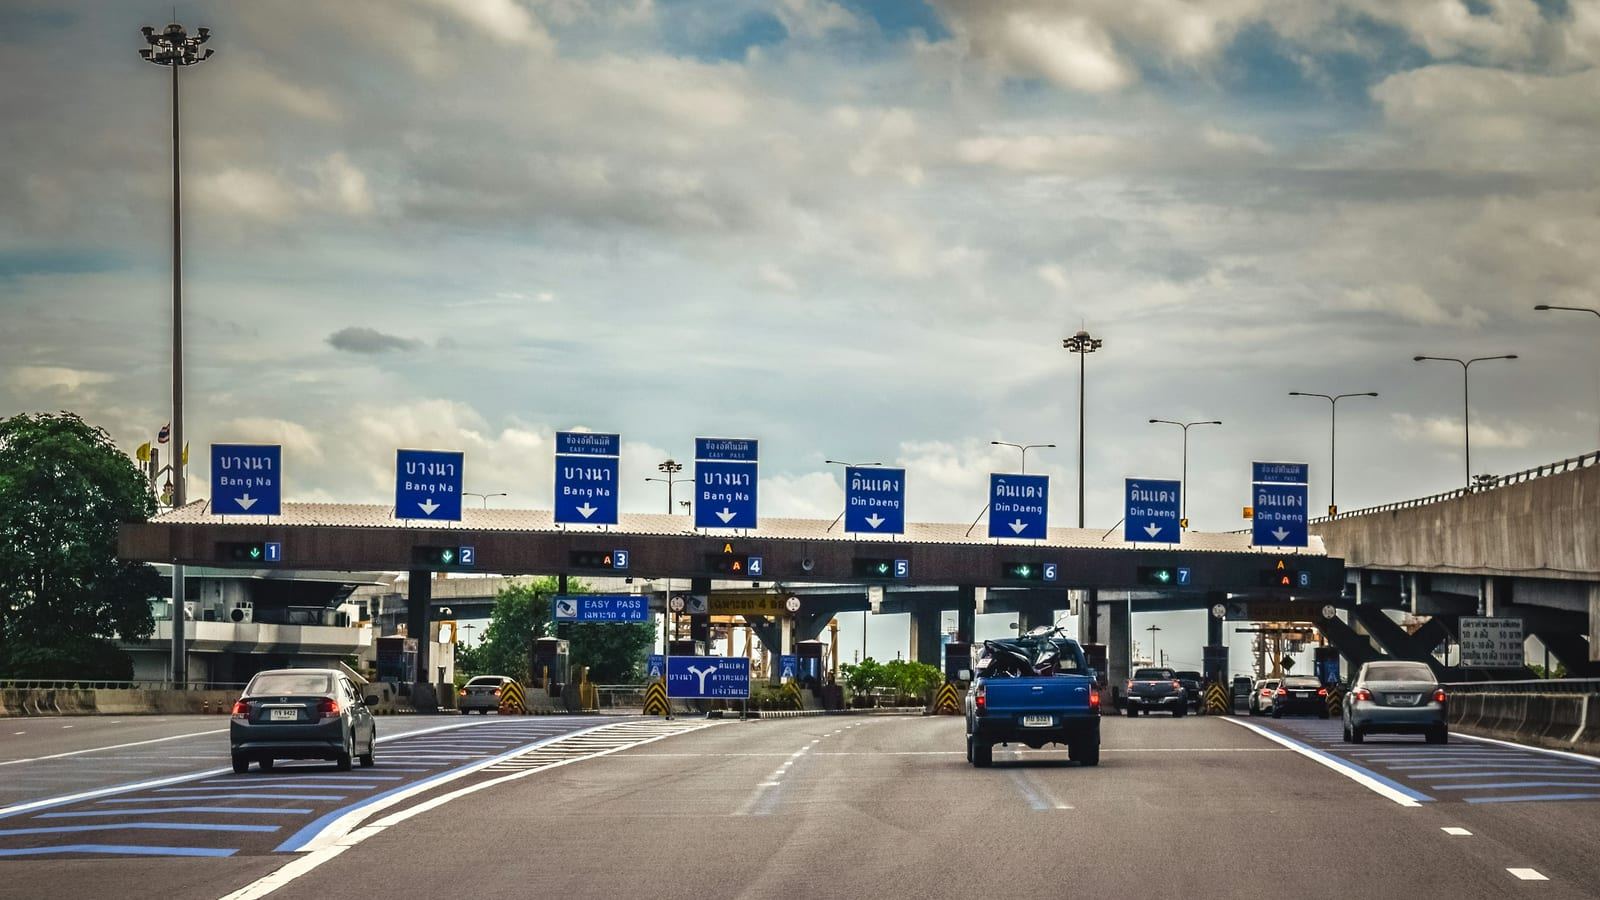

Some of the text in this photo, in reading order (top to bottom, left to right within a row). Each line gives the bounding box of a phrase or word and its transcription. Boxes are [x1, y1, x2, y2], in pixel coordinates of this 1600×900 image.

[221, 456, 272, 470] บางนา
[406, 462, 454, 476] บางนา
[564, 467, 610, 480] บางนา
[704, 473, 749, 485] บางนา
[221, 476, 272, 488] Bang Na
[405, 481, 453, 493] Bang Na
[852, 472, 898, 492] ดินแดง
[564, 486, 610, 497] Bang Na
[996, 479, 1042, 498] ดินแดง
[1131, 483, 1175, 502] ดินแดง
[704, 492, 749, 502] Bang Na
[851, 496, 899, 509] Din Daeng
[1258, 489, 1302, 506] ดินแดง
[995, 502, 1042, 515] Din Daeng
[1130, 506, 1175, 519] Din Daeng
[1258, 512, 1303, 523] Din Daeng
[270, 545, 276, 558] 1
[724, 544, 732, 553] A
[462, 550, 471, 562] 2
[604, 556, 611, 564] A
[617, 554, 625, 565] 3
[750, 560, 760, 572] 4
[898, 562, 906, 574] 5
[1277, 560, 1285, 570] A
[1046, 566, 1054, 578] 6
[1180, 570, 1187, 582] 7
[1282, 576, 1290, 584] A
[1301, 574, 1308, 585] 8
[585, 600, 641, 608] EASY PASS
[718, 660, 745, 670] ดินแดง
